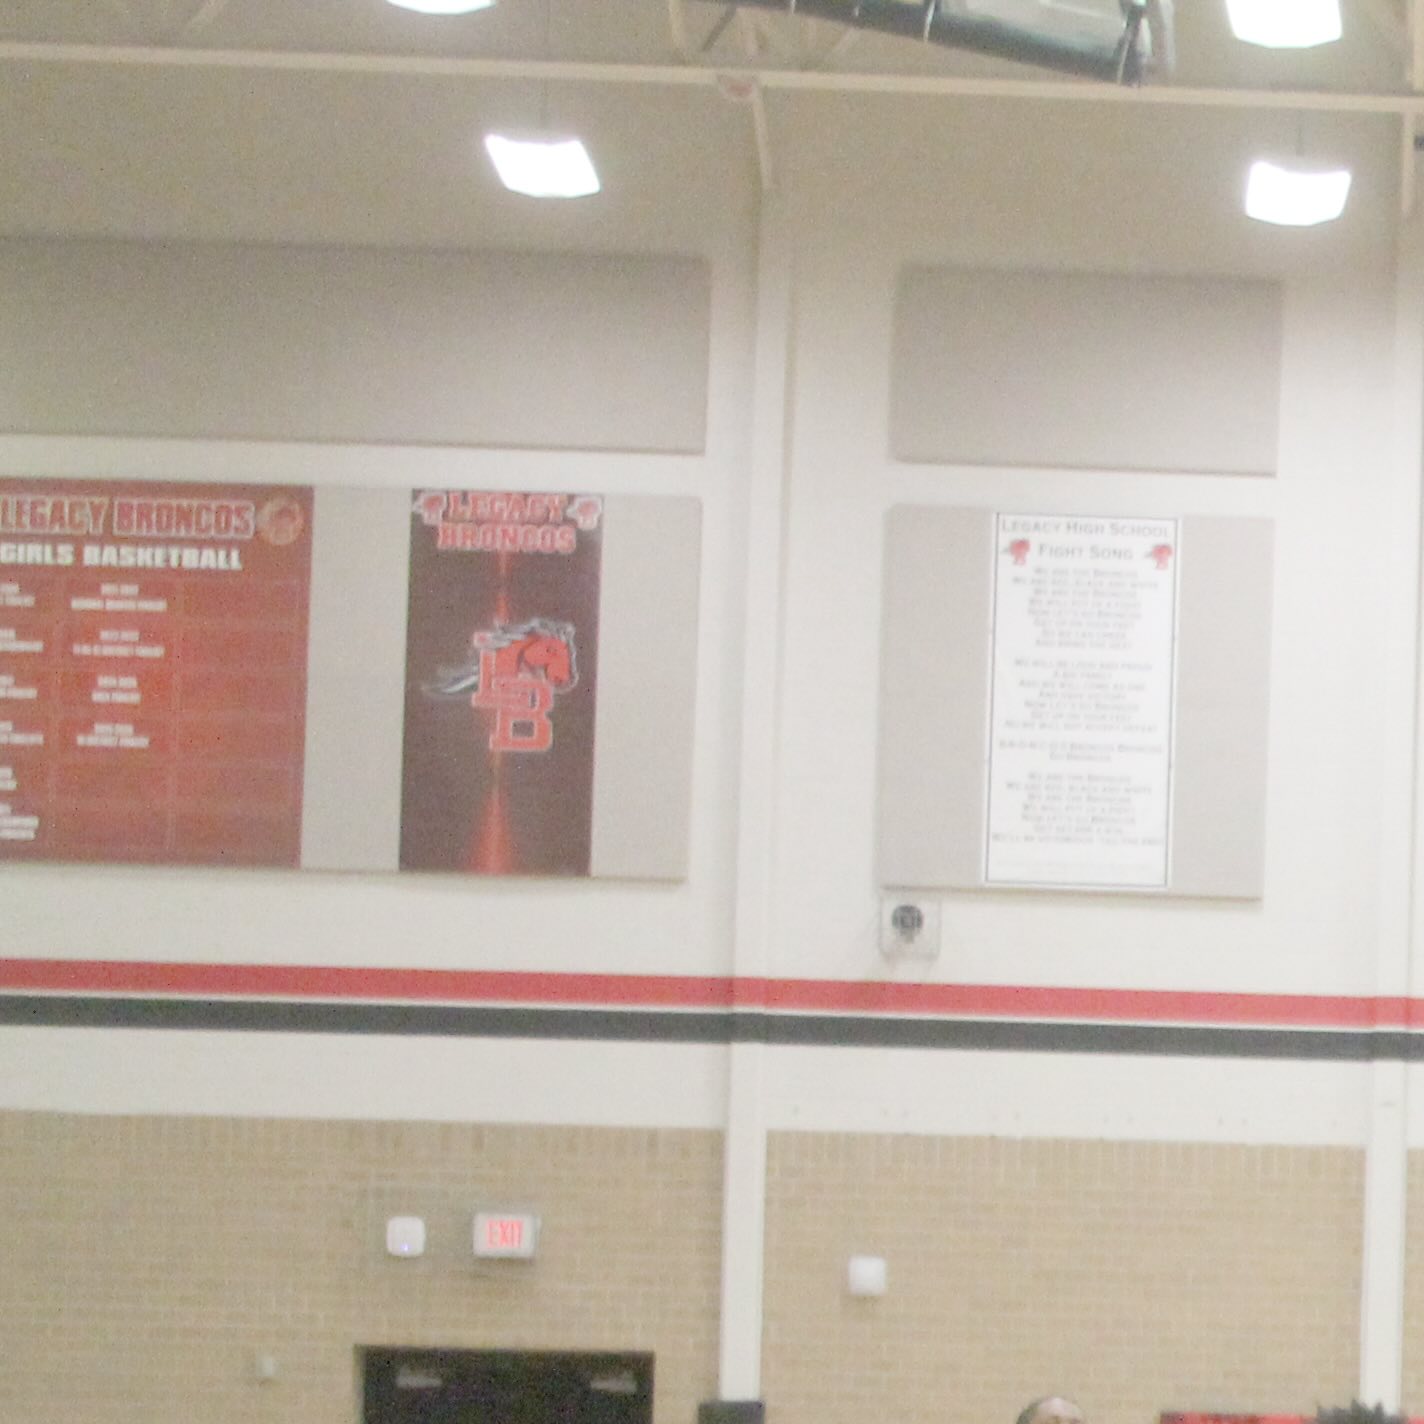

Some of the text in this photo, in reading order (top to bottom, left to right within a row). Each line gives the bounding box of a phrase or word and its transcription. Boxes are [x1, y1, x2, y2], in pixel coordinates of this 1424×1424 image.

[112, 497, 256, 540] BRONCOS
[446, 493, 568, 522] LEGACY
[437, 523, 576, 553] BRONCOS
[1001, 518, 1169, 538] LEGACY HIGH SCHOOL
[0, 543, 242, 570] GIRLS BASKETBALL
[1089, 545, 1133, 561] SONG
[487, 1219, 523, 1249] EXIT
